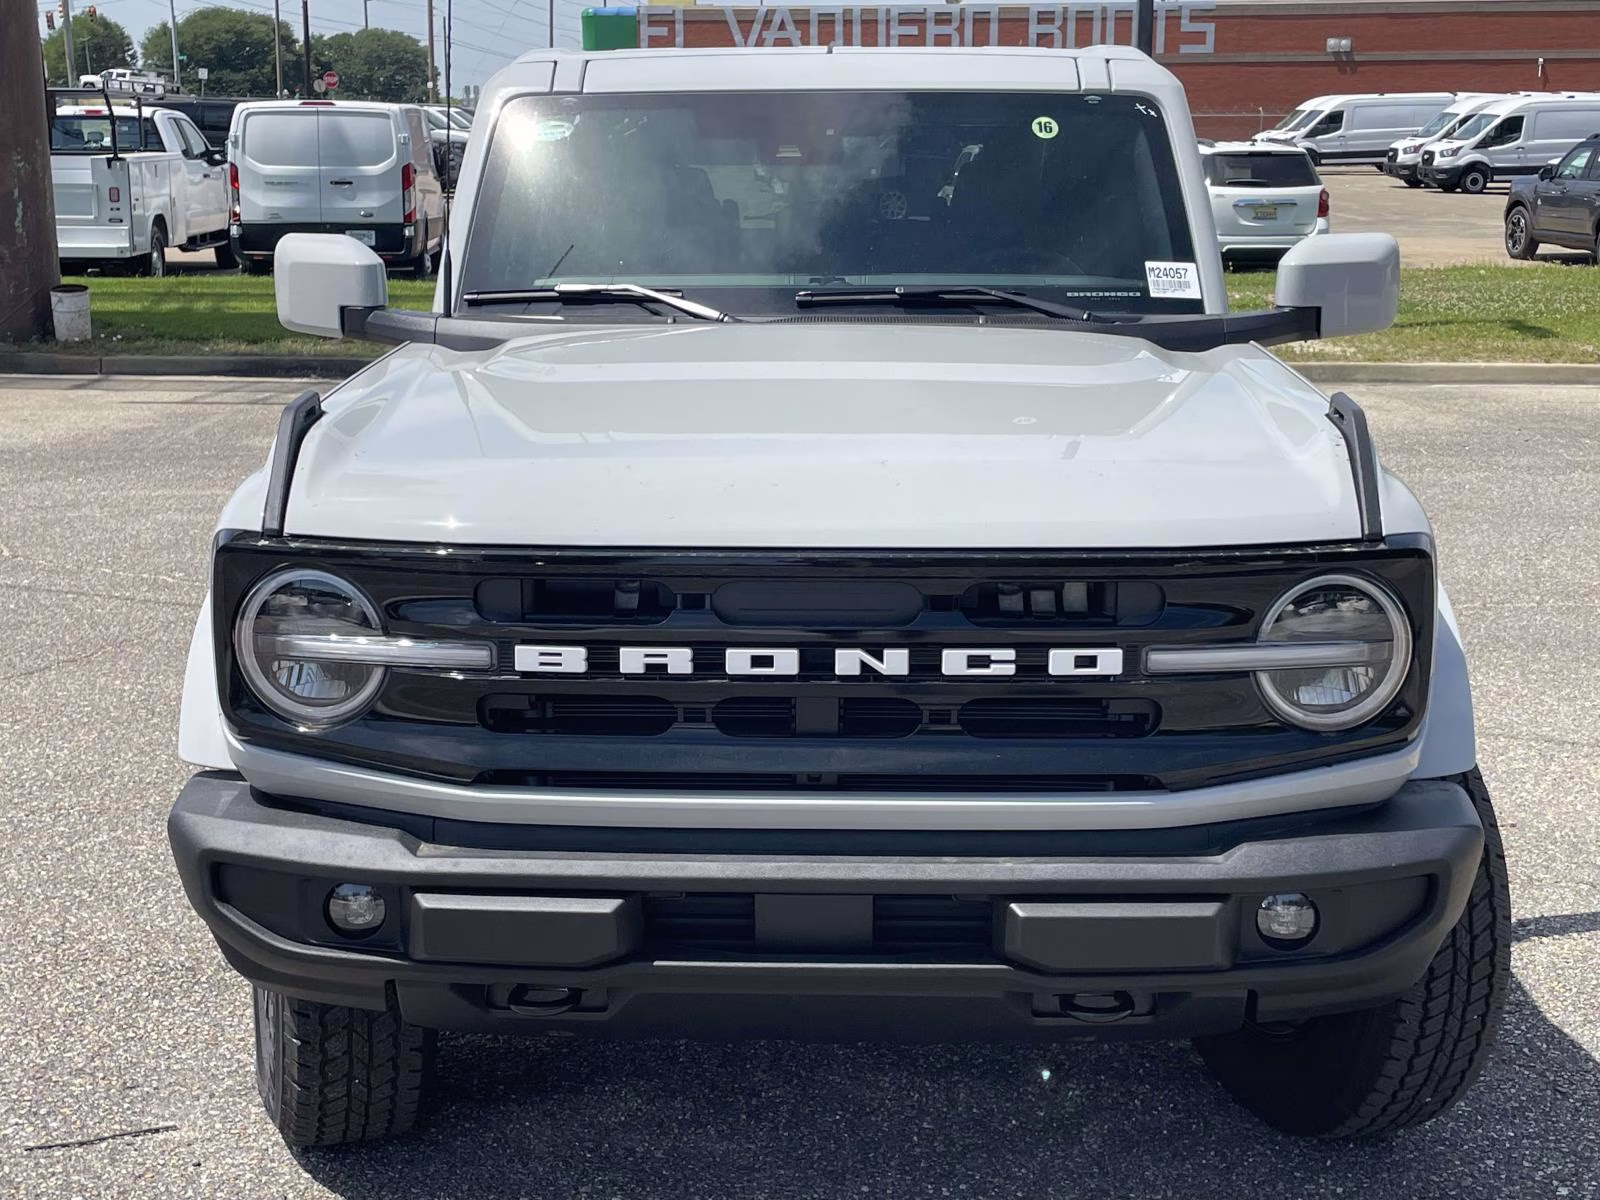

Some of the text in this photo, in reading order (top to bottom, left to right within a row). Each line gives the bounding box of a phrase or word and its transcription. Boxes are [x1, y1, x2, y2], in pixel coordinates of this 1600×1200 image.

[1028, 1, 1216, 54] BOOTS
[1034, 120, 1054, 135] 16
[1147, 266, 1189, 280] M24057
[514, 644, 1123, 676] BRONCO
